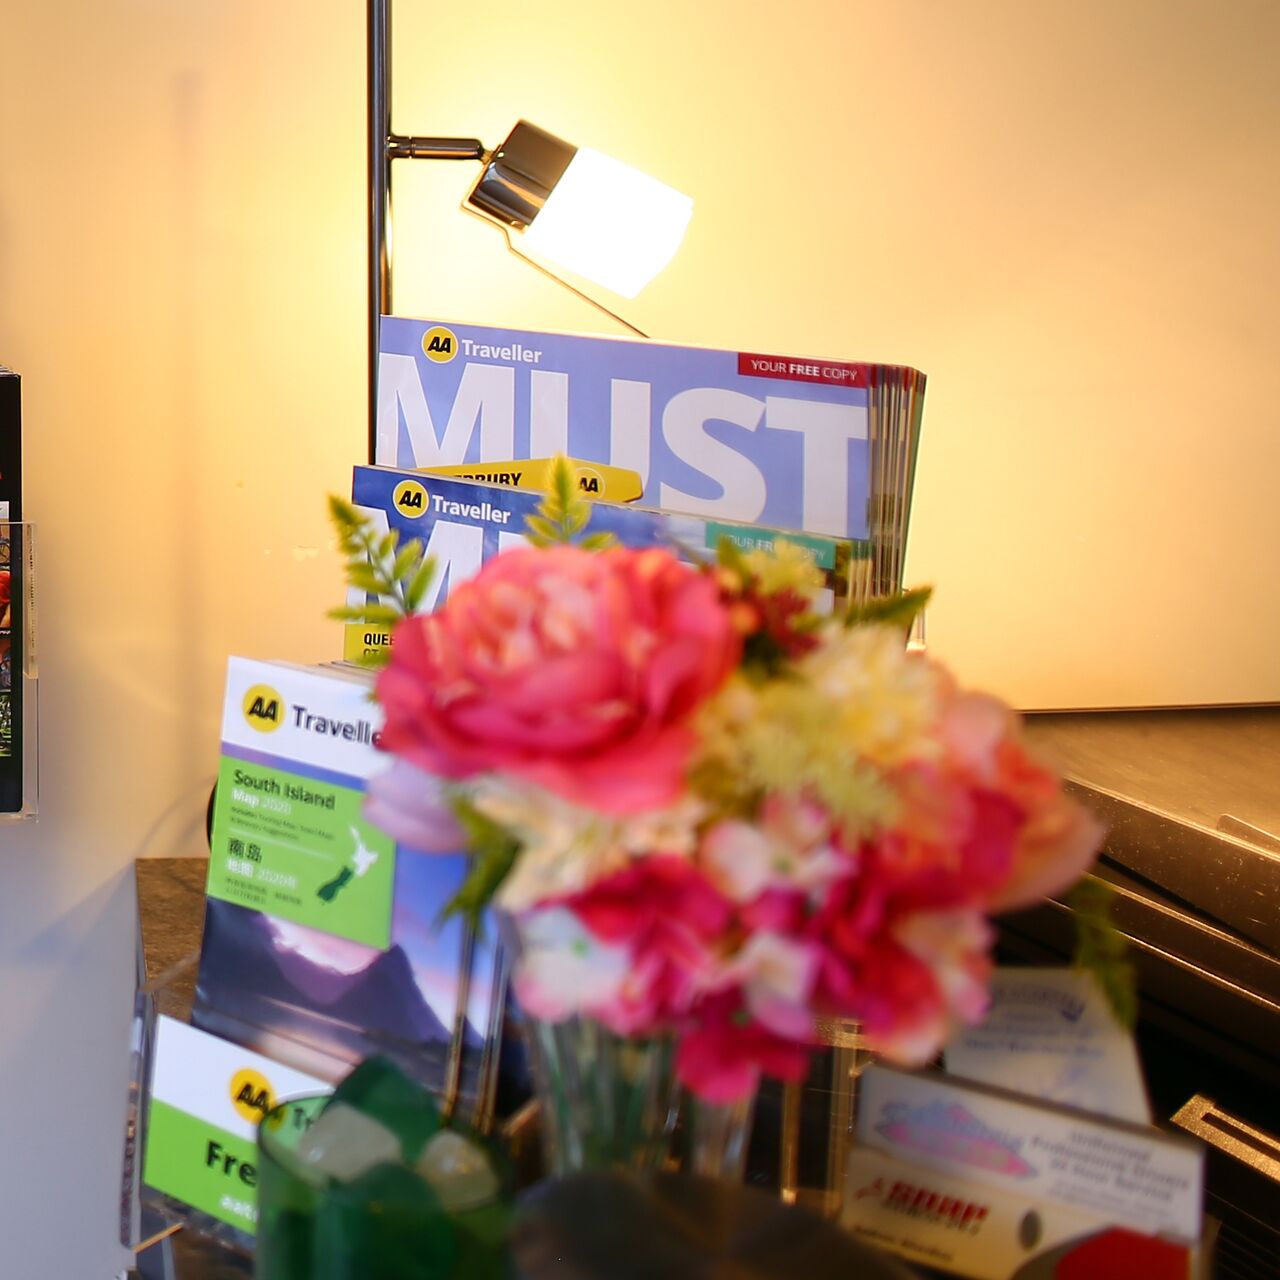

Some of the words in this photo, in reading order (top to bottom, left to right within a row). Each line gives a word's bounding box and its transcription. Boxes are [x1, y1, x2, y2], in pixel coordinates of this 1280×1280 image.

[462, 339, 542, 364] Traveller
[751, 359, 787, 375] YOUR
[789, 362, 820, 377] FREE
[822, 366, 858, 381] COPY
[375, 351, 870, 542] MUST
